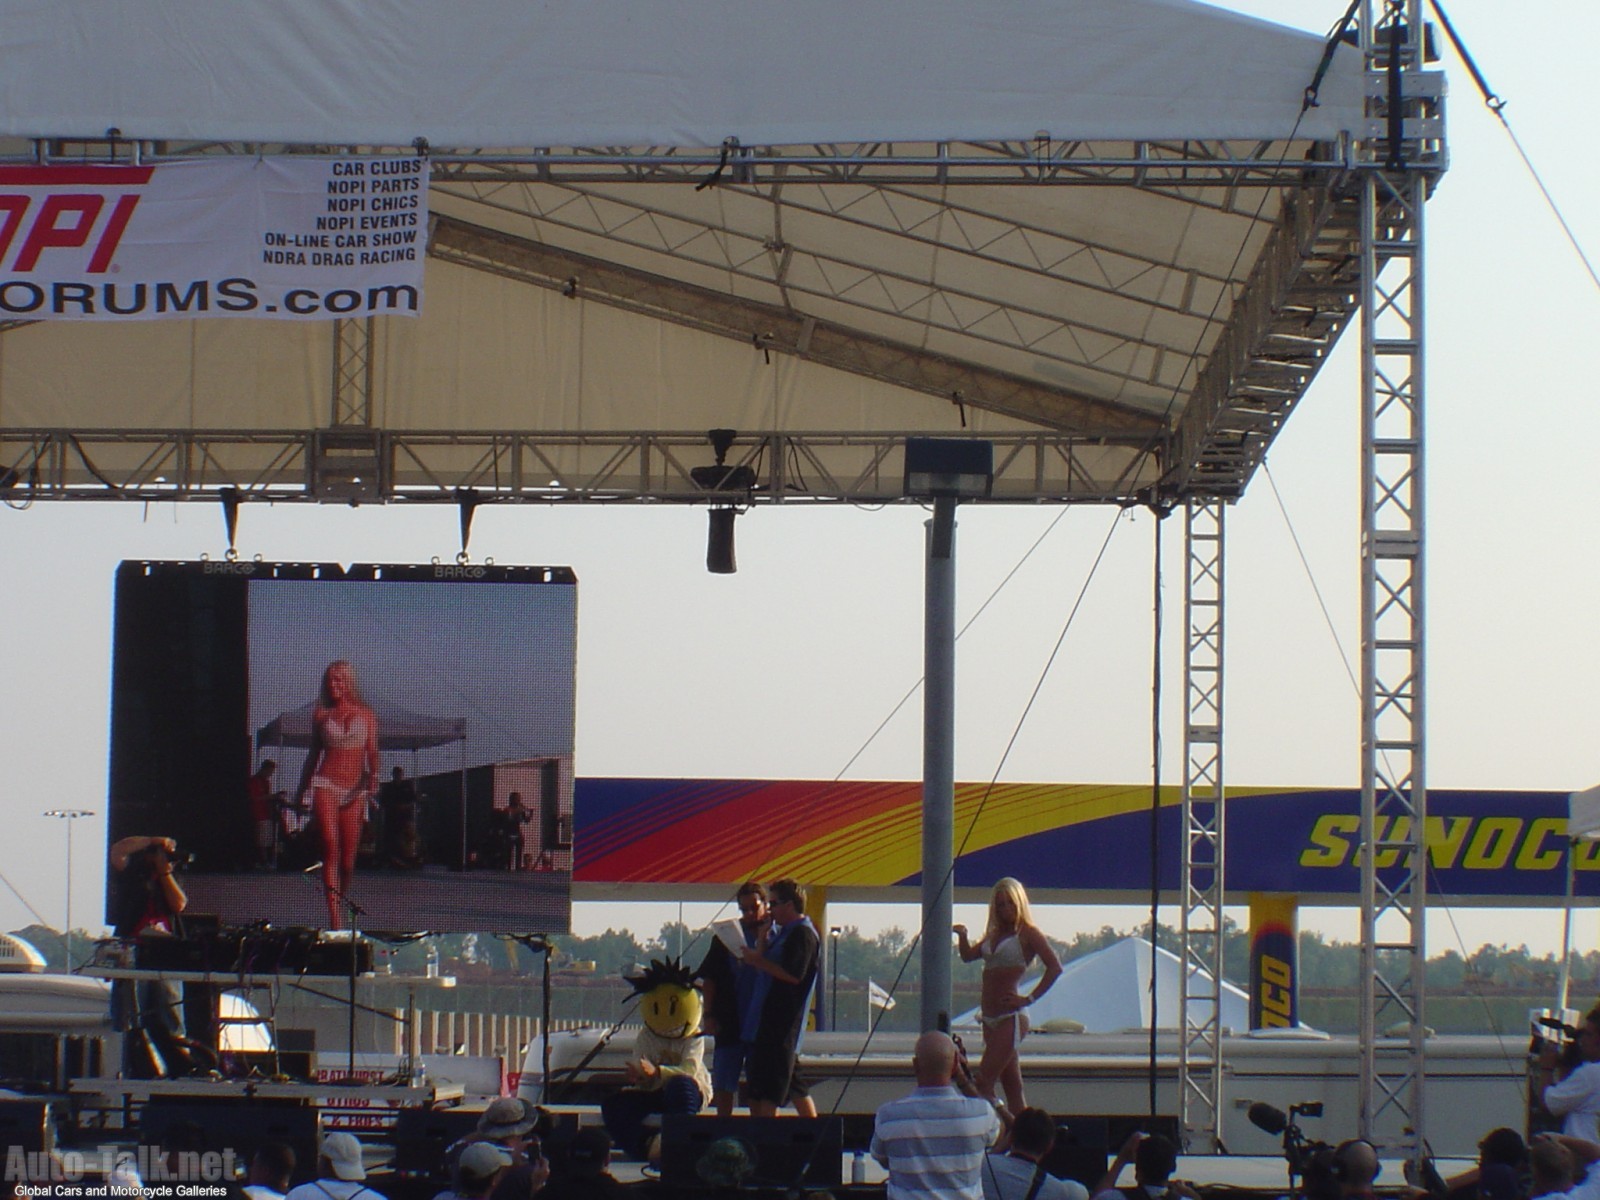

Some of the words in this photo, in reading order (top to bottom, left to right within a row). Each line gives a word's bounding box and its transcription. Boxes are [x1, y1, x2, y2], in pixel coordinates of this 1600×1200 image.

[333, 162, 365, 176] CAR
[371, 160, 421, 175] CLUBS
[328, 180, 365, 194] NOPI
[372, 178, 420, 193] PARTS
[328, 199, 365, 212] NOPI
[371, 195, 418, 211] CHICS
[317, 217, 354, 230] NOPI
[361, 213, 418, 229] EVENTS
[265, 232, 329, 248] ON-LINE
[335, 235, 367, 248] CAR
[373, 231, 417, 247] SHOW
[263, 250, 306, 265] NDRA
[312, 253, 354, 266] DRAG
[360, 248, 415, 265] RACING
[434, 566, 487, 578] BARCO
[1299, 814, 1600, 870] SUNOC
